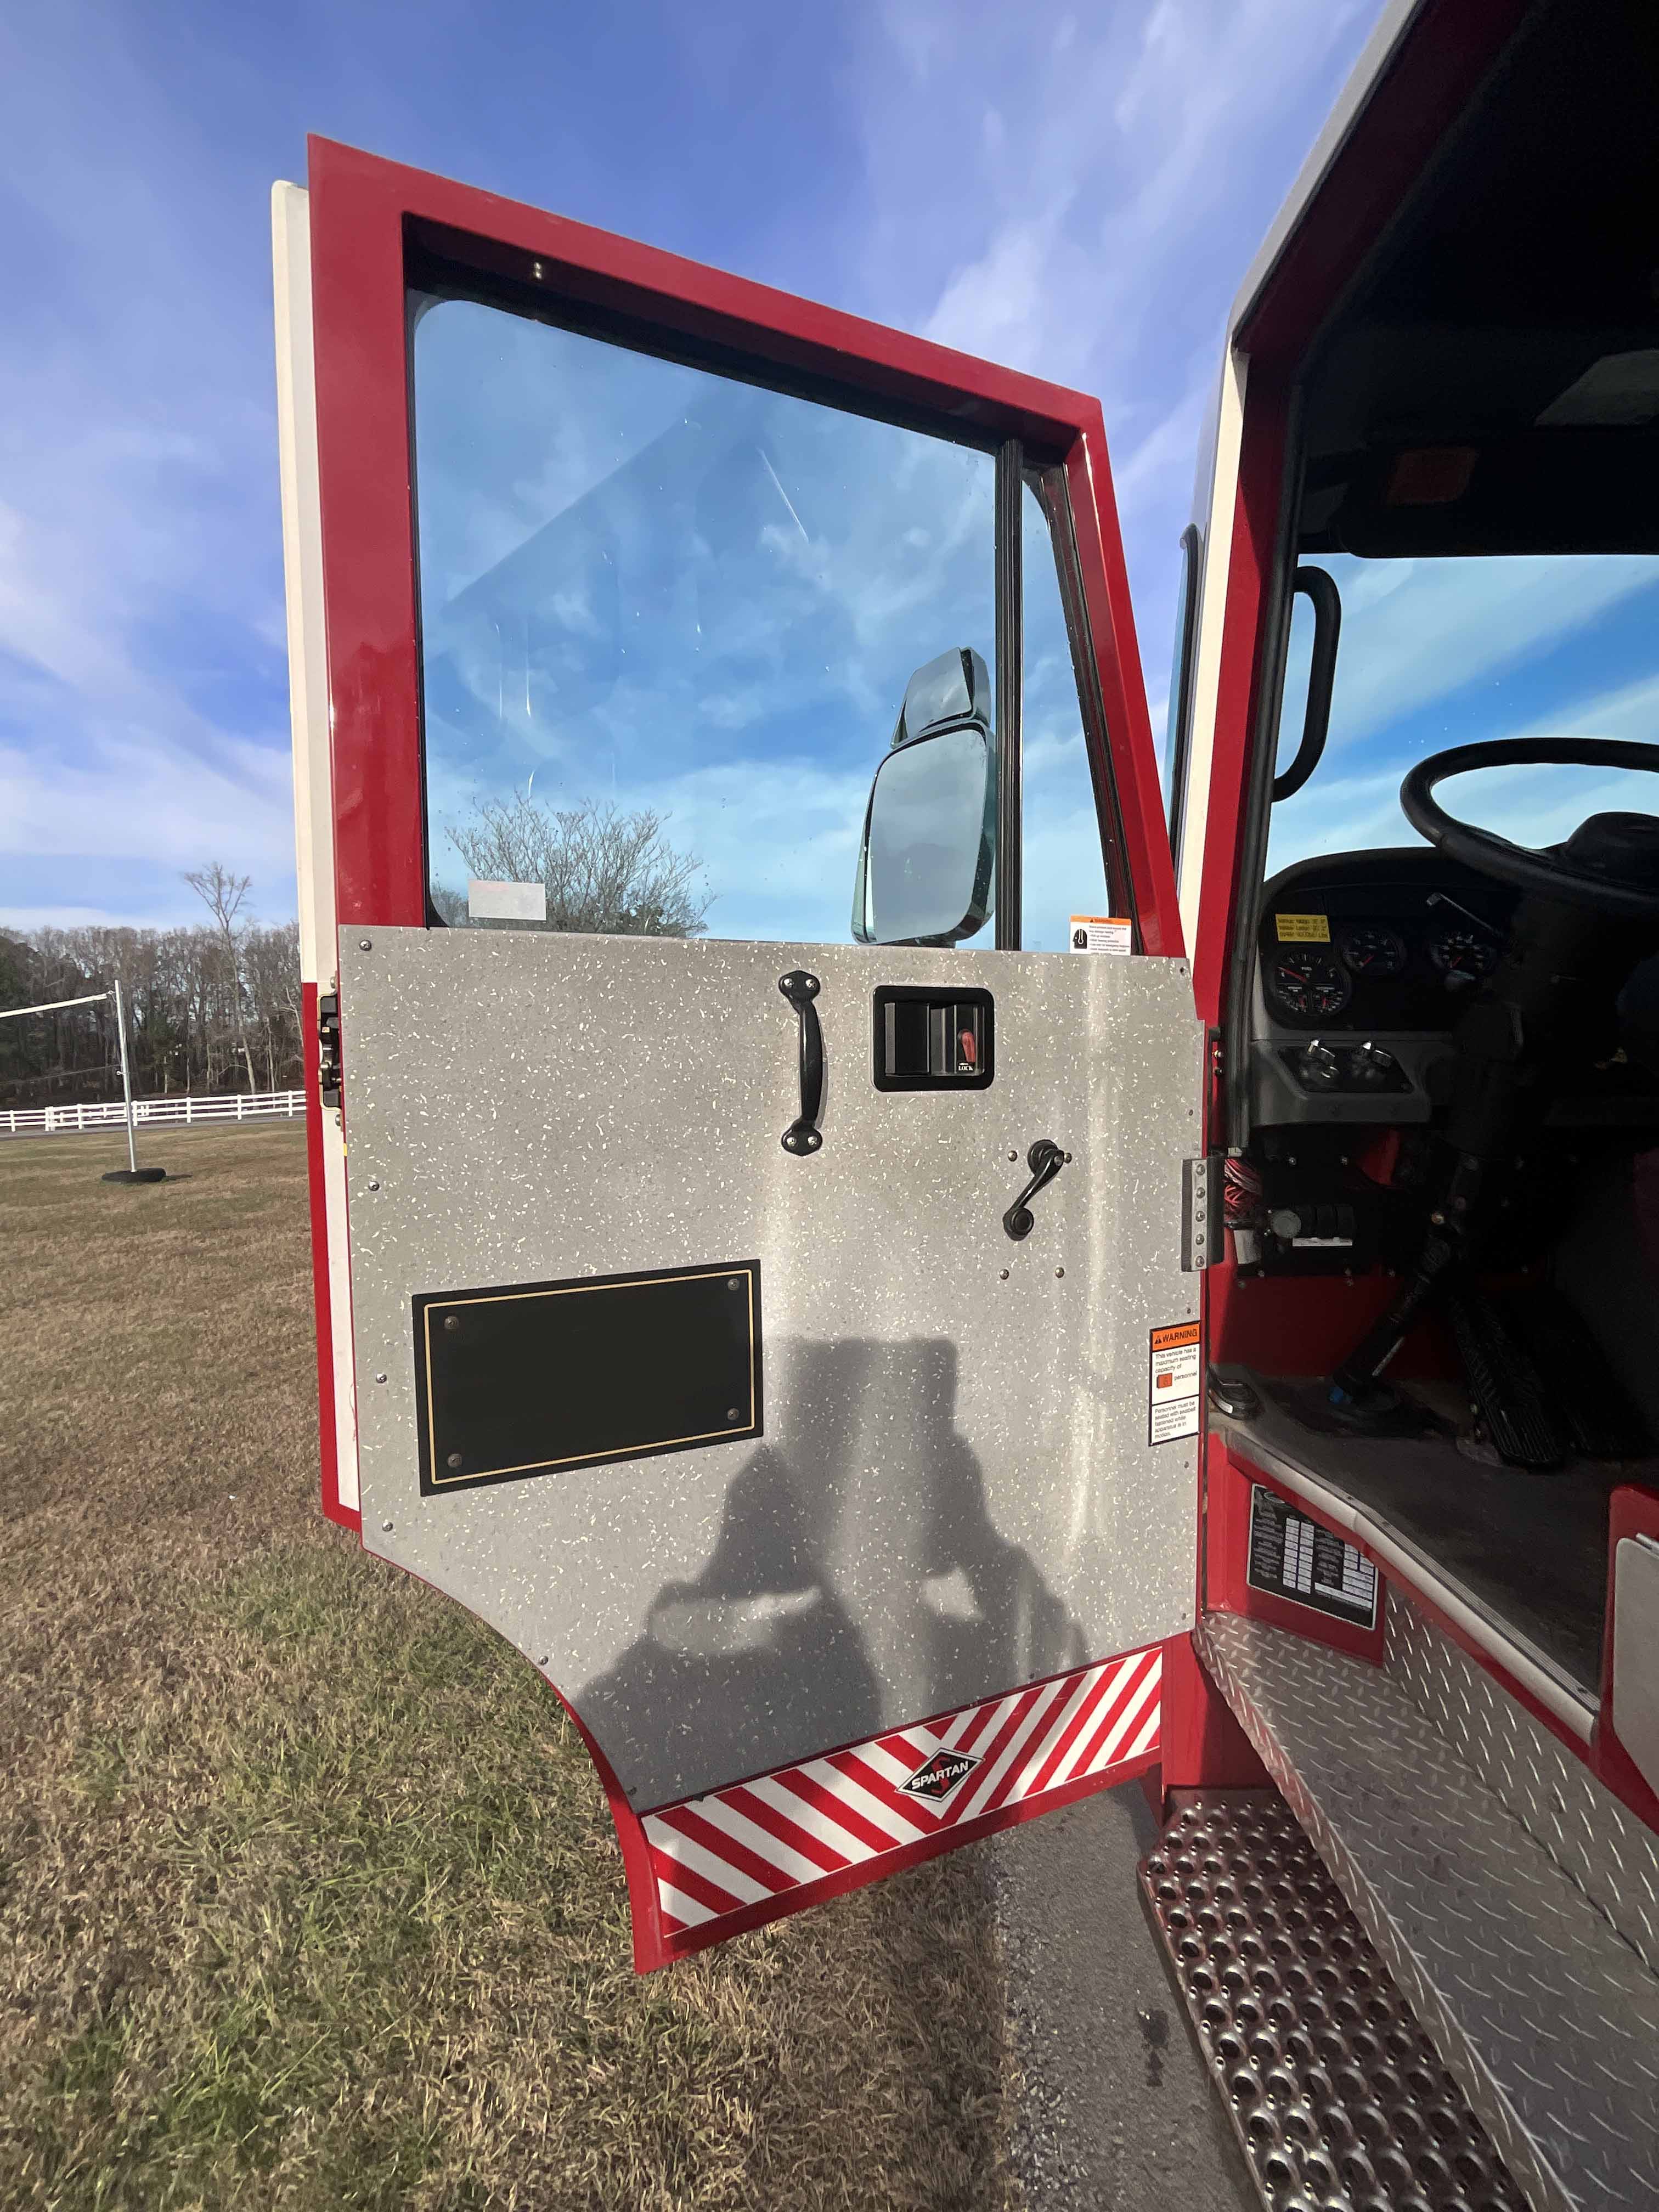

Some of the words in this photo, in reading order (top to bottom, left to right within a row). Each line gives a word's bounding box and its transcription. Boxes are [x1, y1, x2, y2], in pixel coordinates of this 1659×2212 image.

[1163, 1329, 1197, 1342] WARNING
[1155, 1365, 1176, 1373] capacity
[1174, 1370, 1197, 1381] personnel
[912, 1760, 968, 1790] SPARTAN
